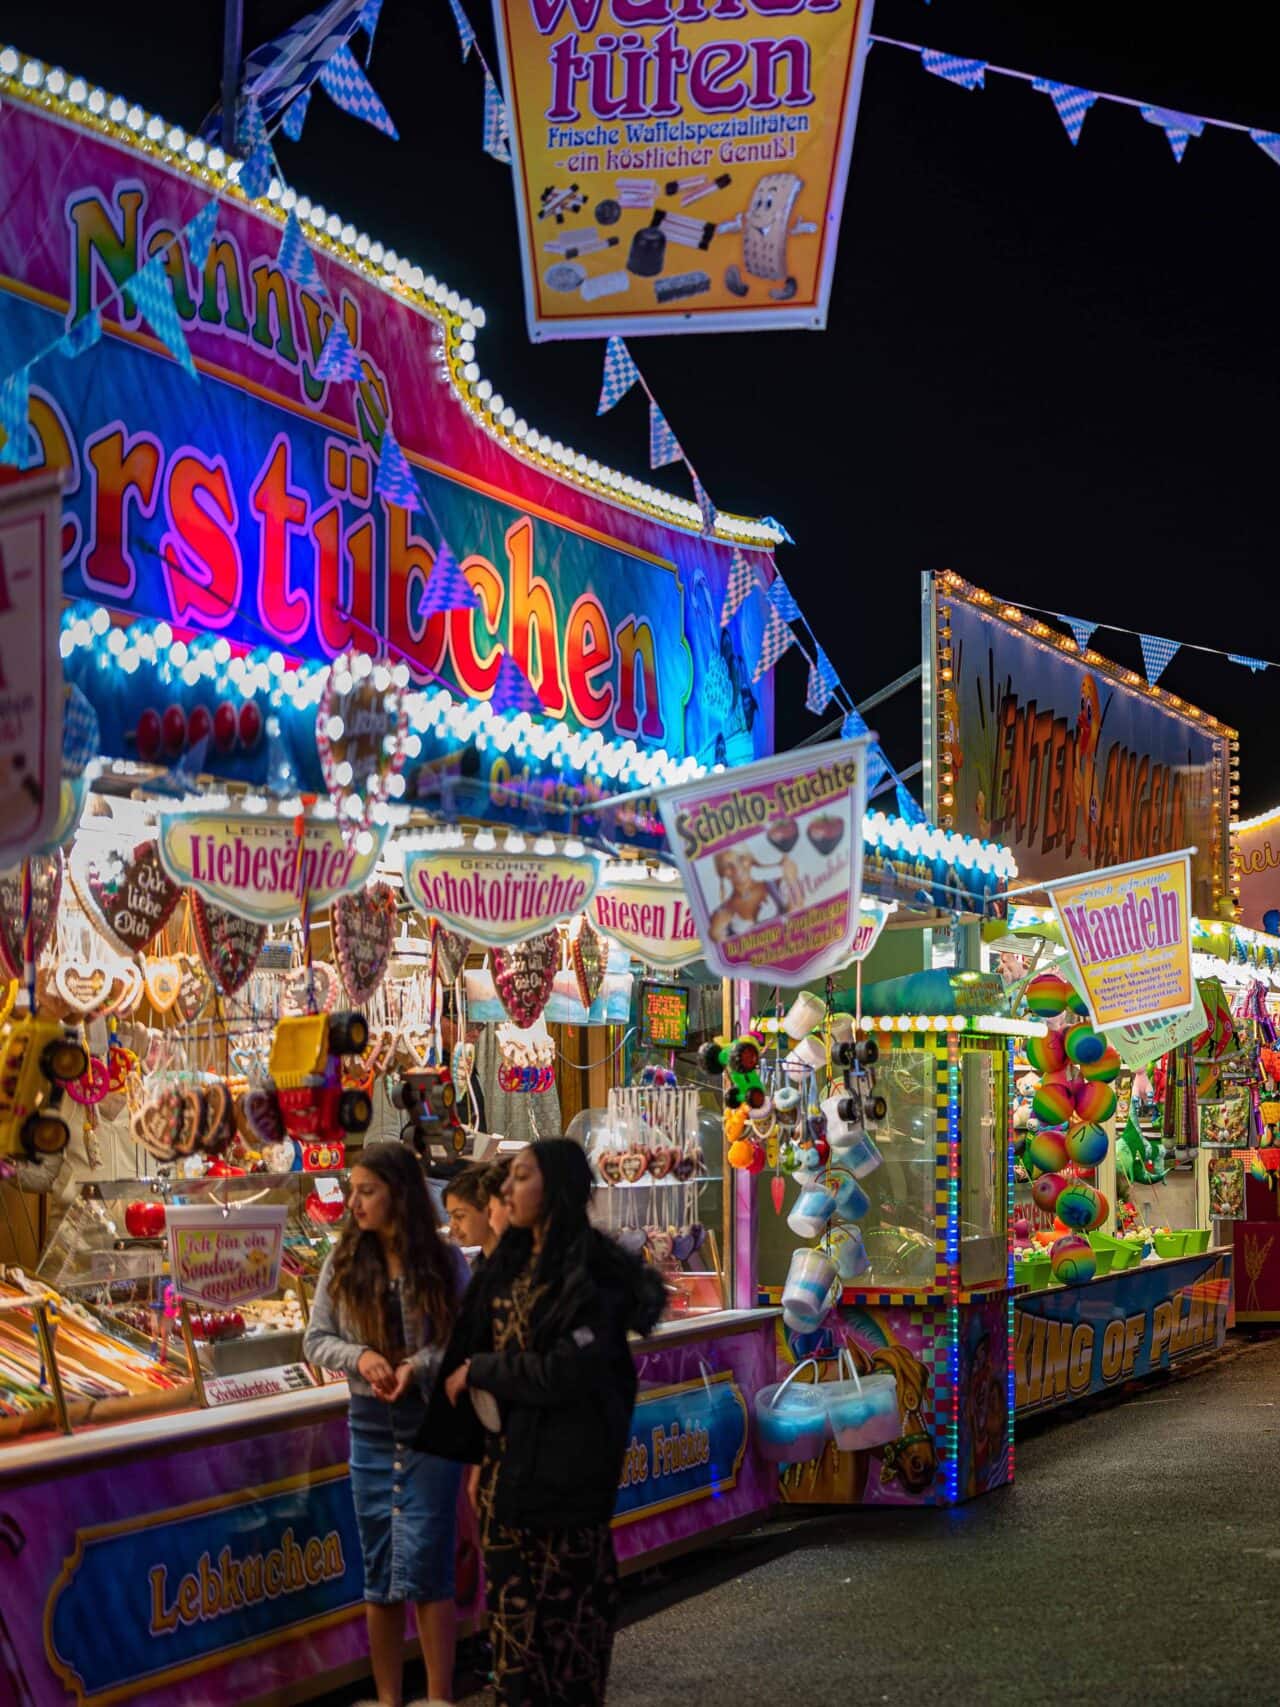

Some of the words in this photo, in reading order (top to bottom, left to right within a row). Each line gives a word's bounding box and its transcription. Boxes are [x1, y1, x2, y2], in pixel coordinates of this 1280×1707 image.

[547, 25, 813, 122] tüten
[547, 123, 619, 148] Frische
[626, 114, 810, 145] Waffelspezialitäten
[606, 144, 714, 170] köstlicher
[720, 137, 797, 163] Genuß!
[67, 180, 390, 452] Nanny's
[1096, 741, 1187, 869] ANGELN
[189, 834, 357, 900] Liebesäpfel
[418, 868, 587, 924] Schokofrüchte
[460, 858, 547, 872] GEKÜHLTE
[127, 884, 162, 917] liebe
[595, 895, 666, 941] Riesen
[1063, 885, 1183, 967] Mandeln
[1013, 1309, 1096, 1409] KING
[1101, 1313, 1146, 1382] OF
[651, 1419, 711, 1479] Früchte
[149, 1527, 346, 1637] Lebkuchen
